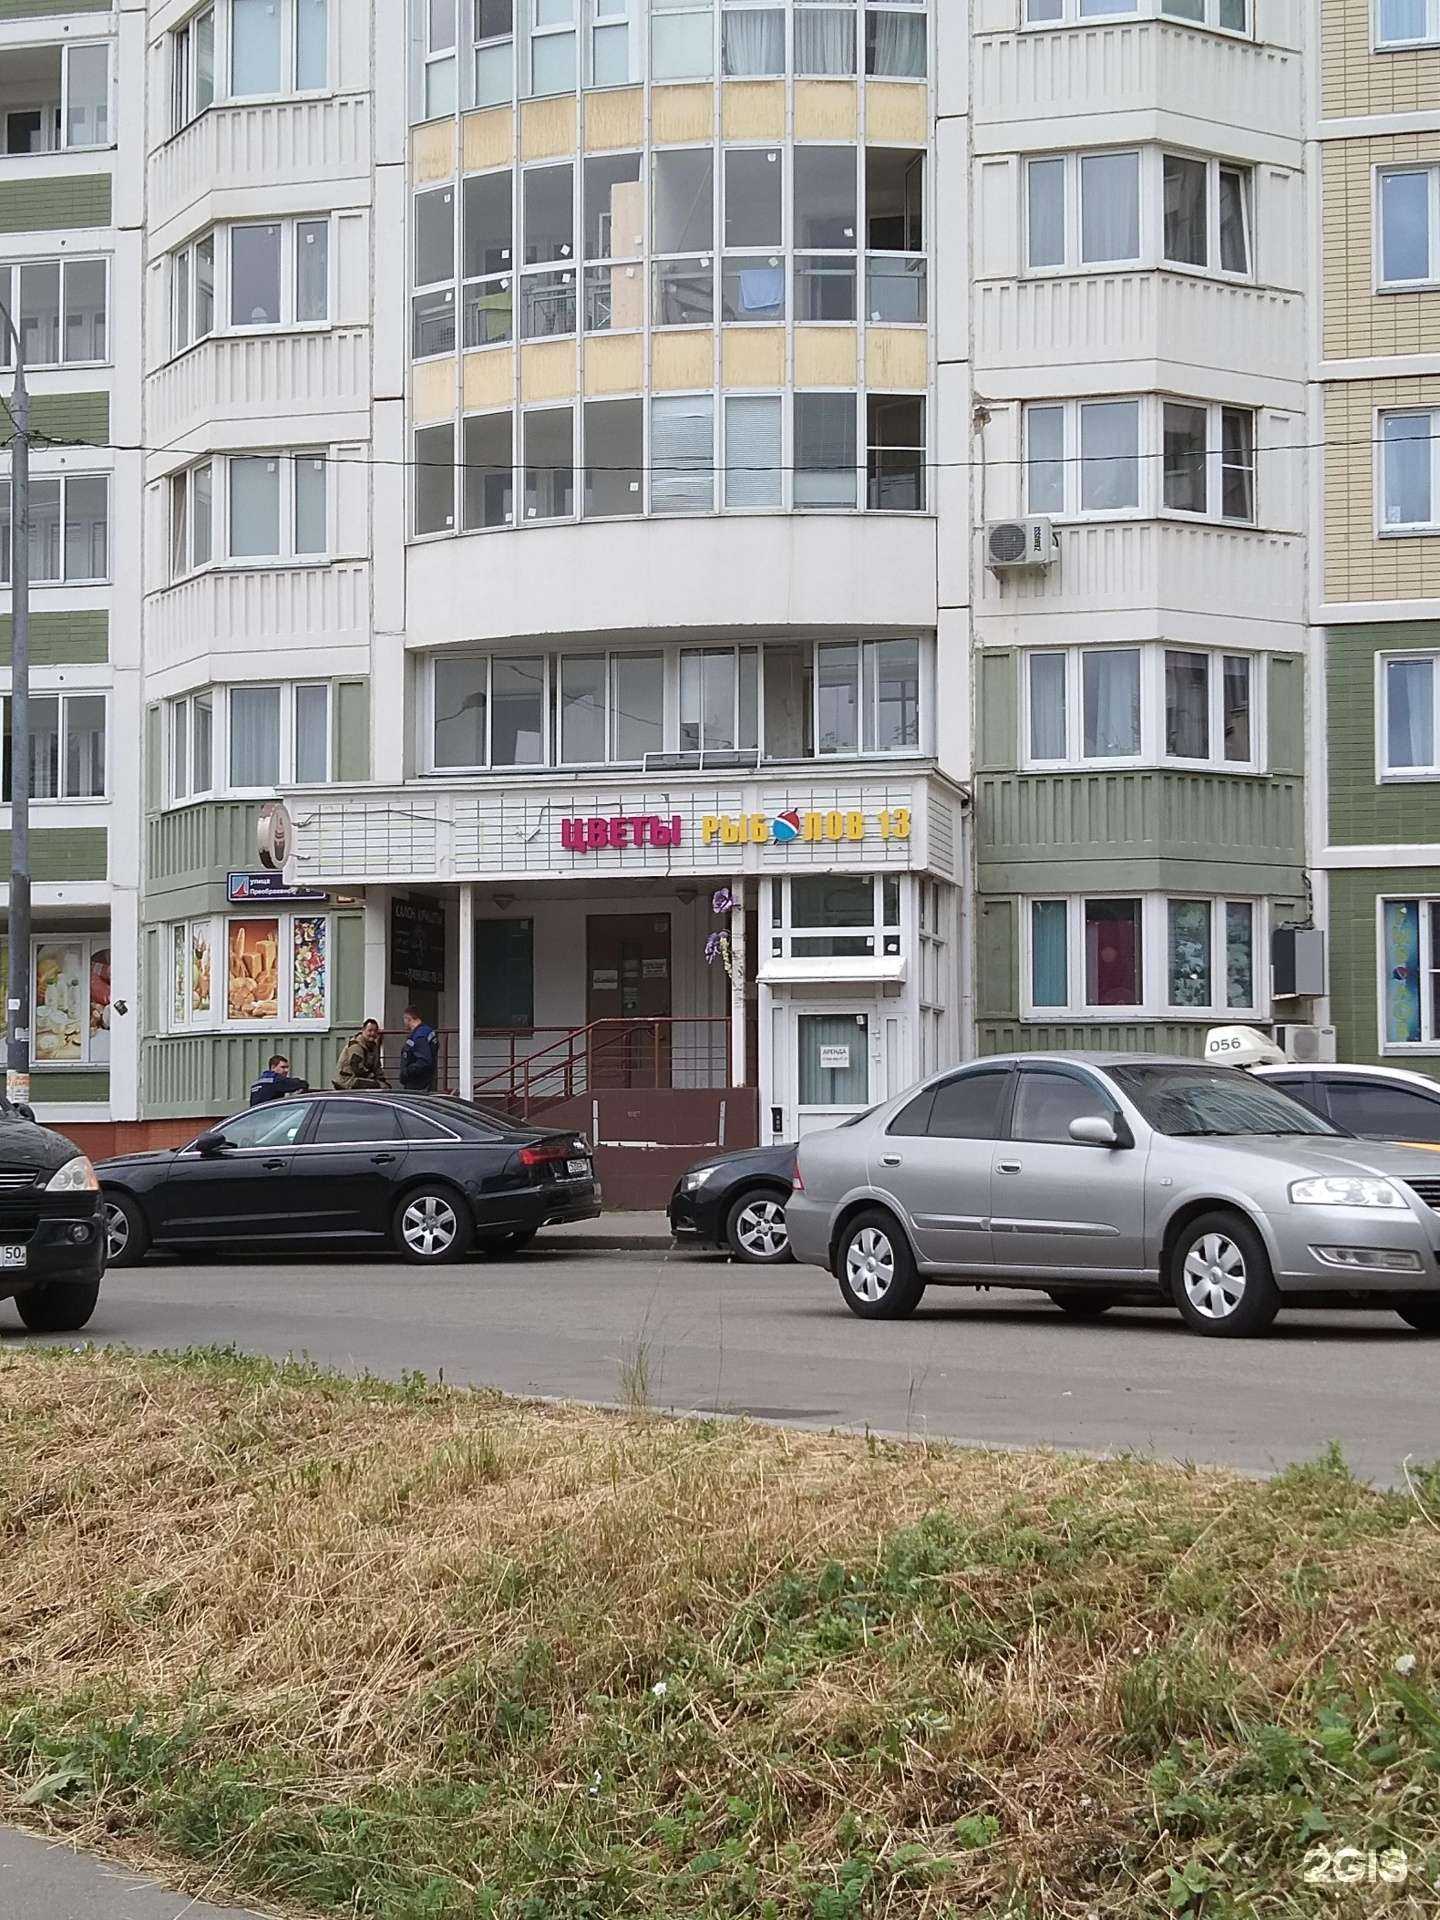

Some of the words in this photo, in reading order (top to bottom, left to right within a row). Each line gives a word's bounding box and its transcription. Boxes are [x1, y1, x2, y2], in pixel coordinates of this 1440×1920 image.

[876, 807, 912, 840] 13
[561, 814, 681, 853] ЦВЕТЫ
[250, 878, 271, 886] улица
[1209, 1037, 1242, 1053] 056
[5, 1246, 21, 1259] 50
